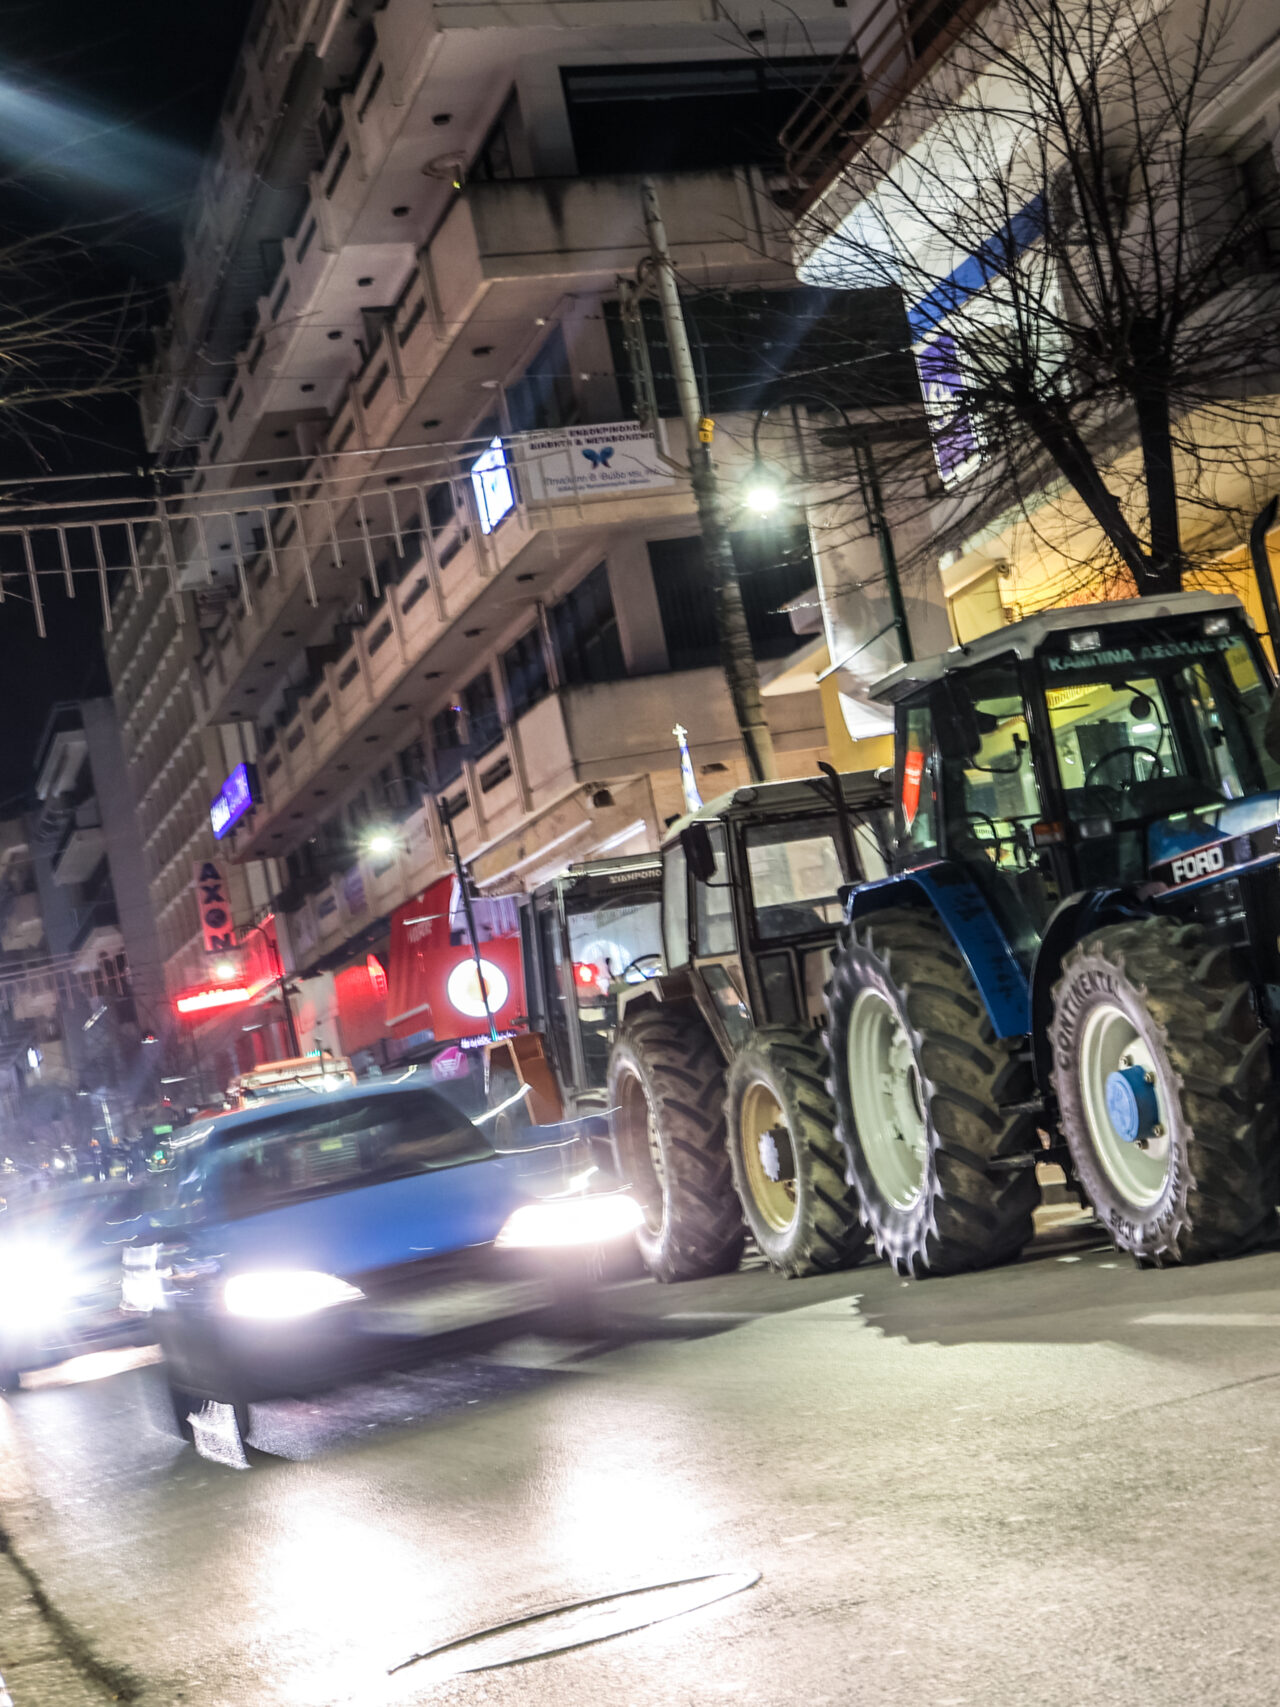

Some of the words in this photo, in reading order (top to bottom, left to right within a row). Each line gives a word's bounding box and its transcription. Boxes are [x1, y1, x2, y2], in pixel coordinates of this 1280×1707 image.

[569, 424, 642, 437] ΕΝΔΟΚΡΙΝΟΛΟ
[586, 432, 656, 445] ΜΕΤΑΒΟΛΙΣΜΟ
[1049, 648, 1135, 672] ΚΑΜΠΙΝΑ
[1172, 847, 1224, 883] FORD
